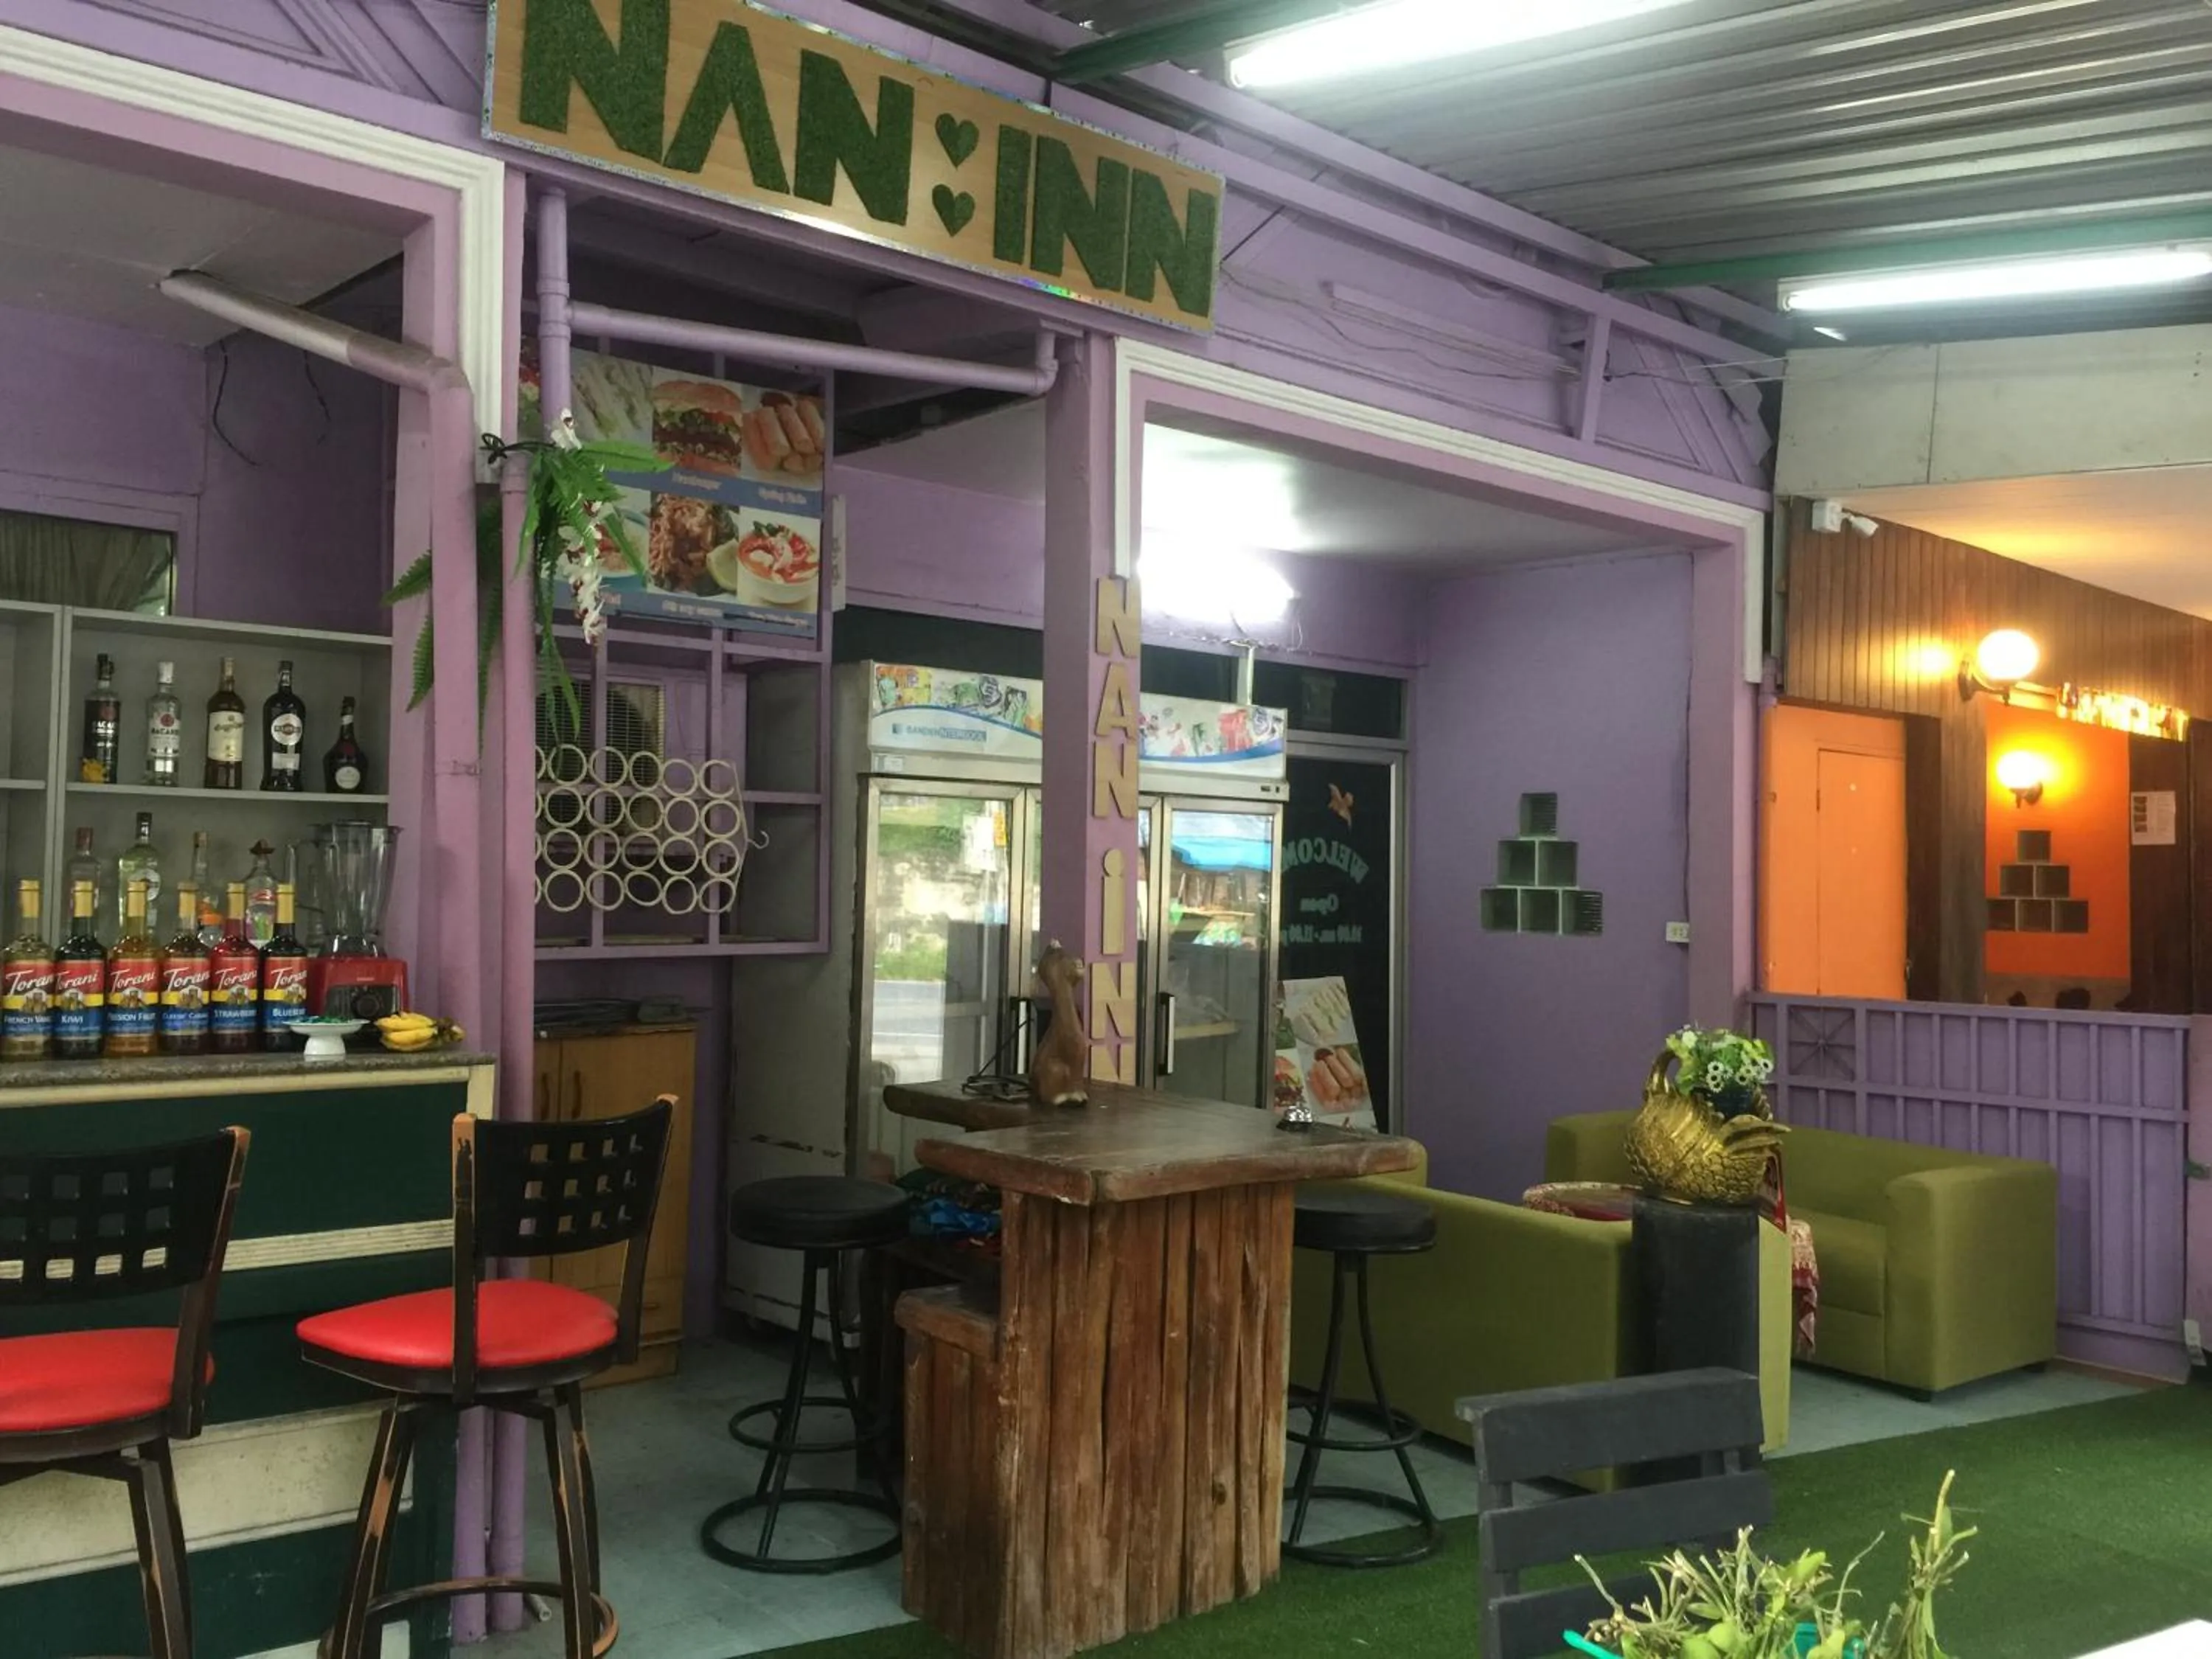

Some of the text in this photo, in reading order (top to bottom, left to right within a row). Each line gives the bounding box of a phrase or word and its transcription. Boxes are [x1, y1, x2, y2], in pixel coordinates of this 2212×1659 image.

[519, 0, 1215, 317] NAN INN
[6, 970, 54, 995] Toran
[111, 968, 156, 993] Torani
